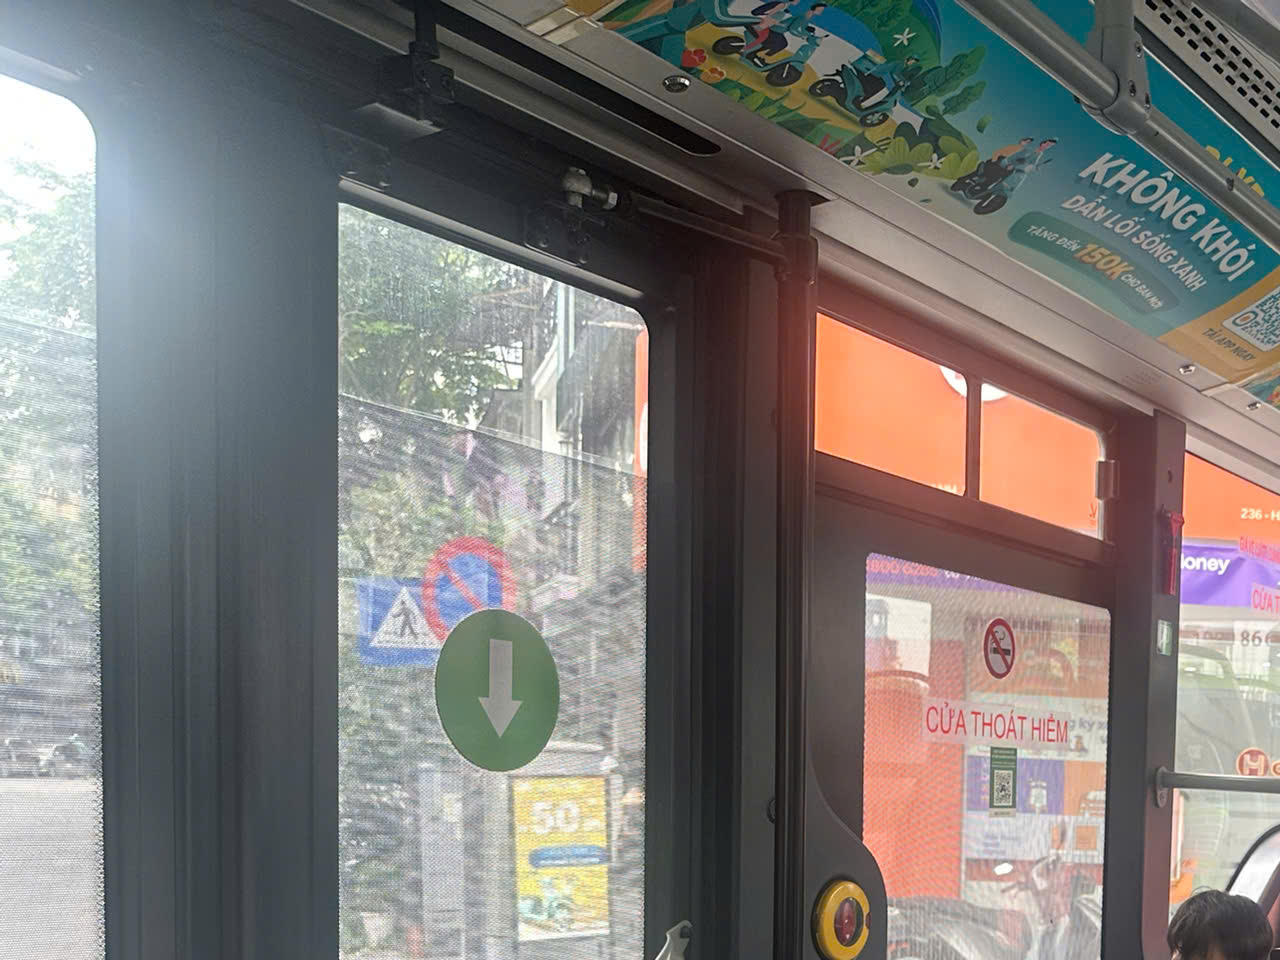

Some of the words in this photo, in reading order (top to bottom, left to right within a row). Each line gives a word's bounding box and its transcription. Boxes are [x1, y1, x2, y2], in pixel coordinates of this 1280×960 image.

[1078, 152, 1206, 231] KHÔNG
[1190, 217, 1256, 282] KHÓI
[1055, 234, 1081, 252] ĐẾN
[1073, 243, 1135, 280] 150K
[1102, 213, 1145, 238] LỐI
[1131, 230, 1178, 263] SỐNG
[1168, 256, 1207, 292] XANH
[1240, 508, 1263, 520] 236
[926, 702, 967, 735] CỬA
[971, 709, 1027, 740] THOÁT
[1031, 713, 1068, 744] HIỂM
